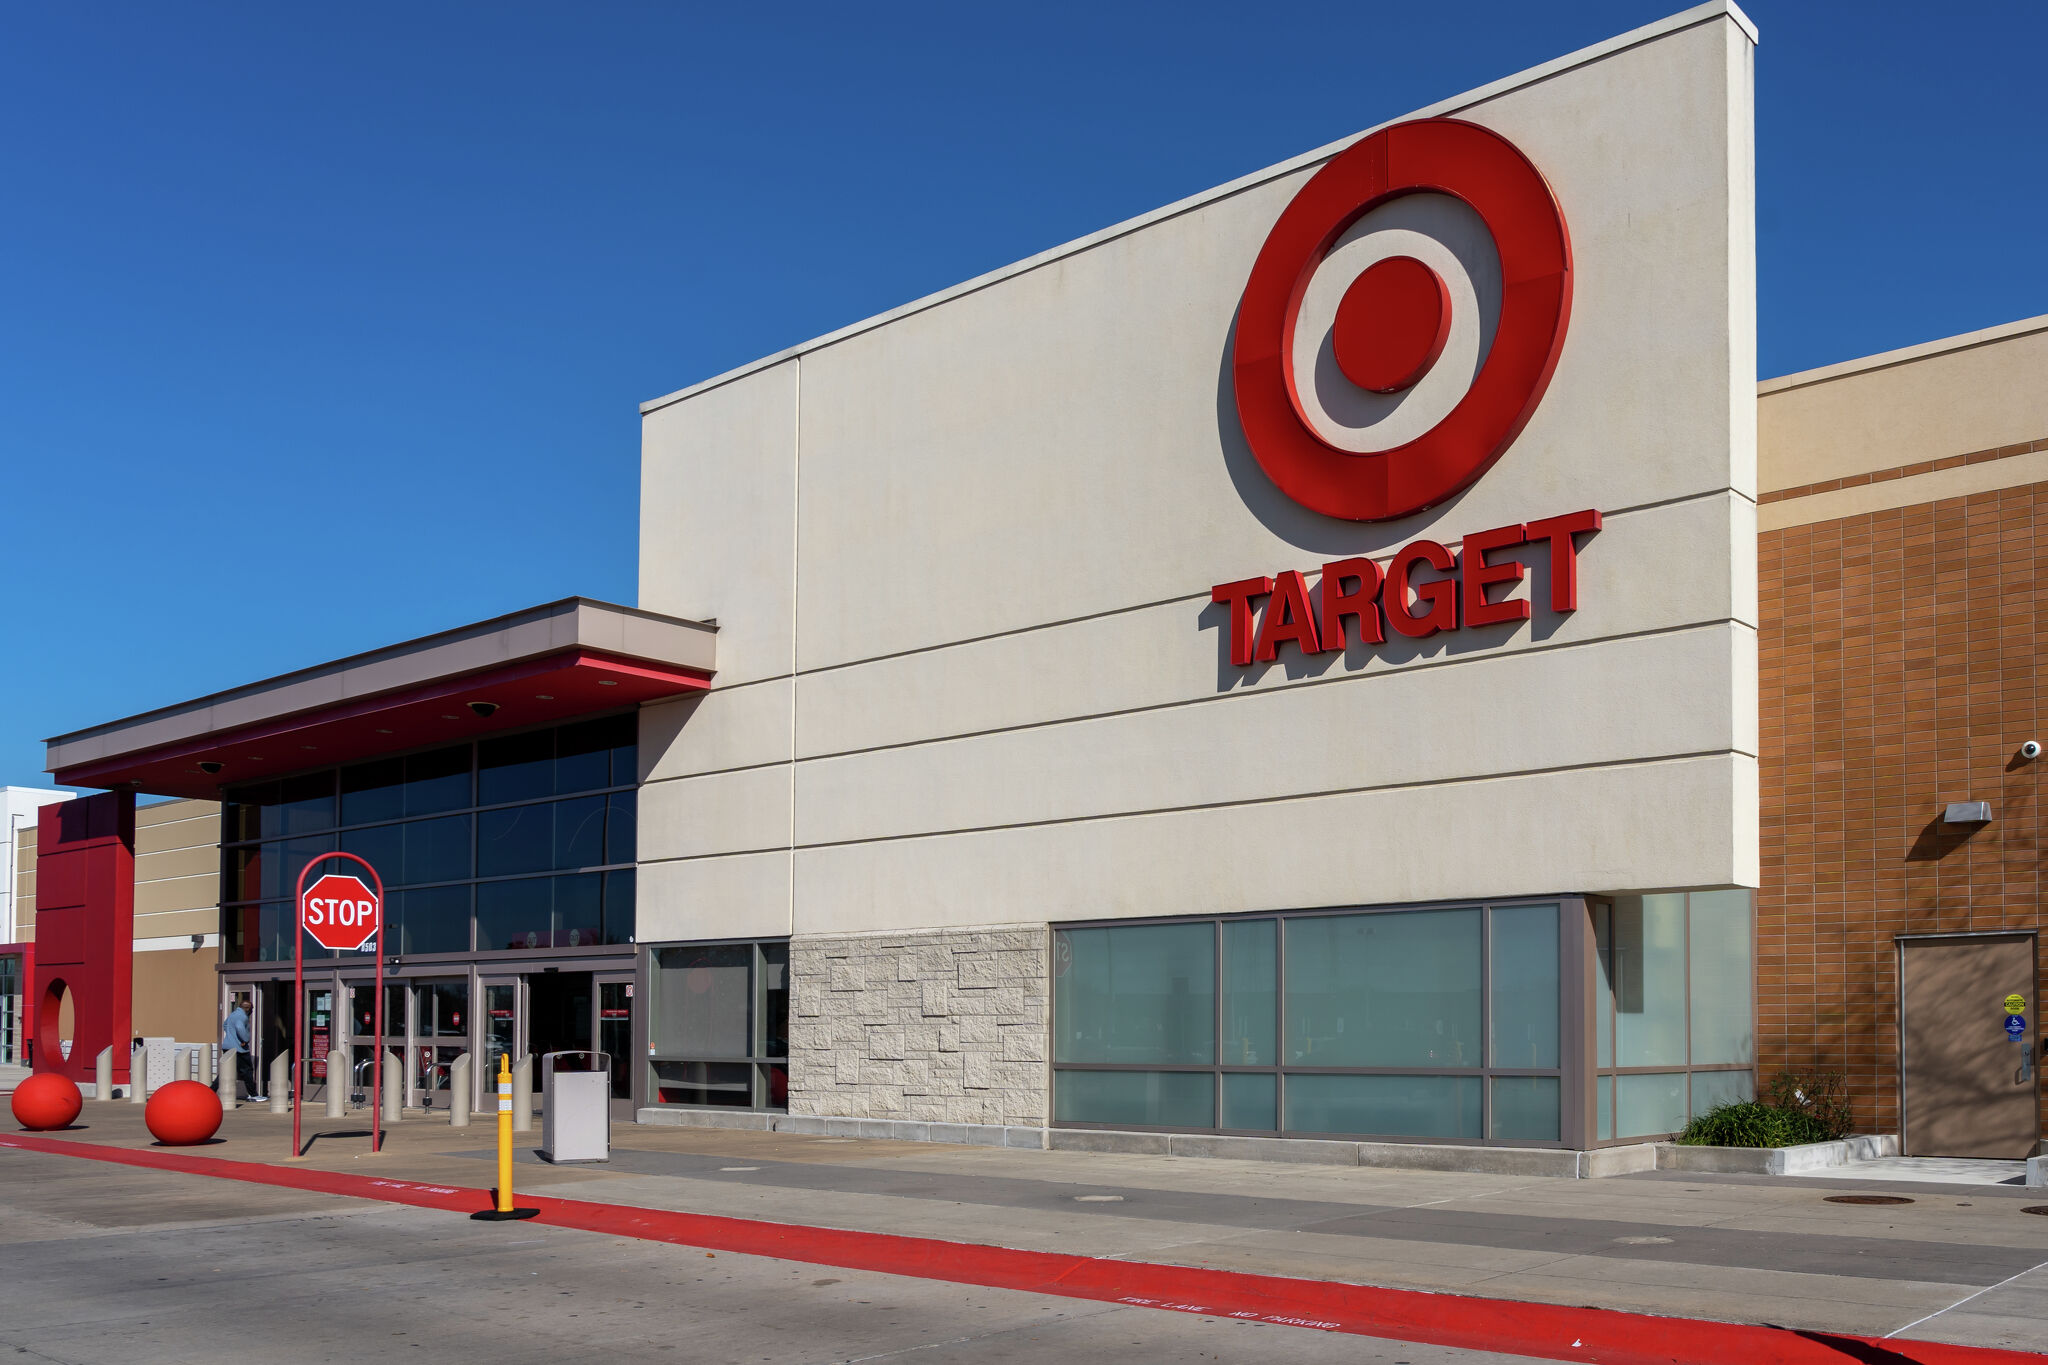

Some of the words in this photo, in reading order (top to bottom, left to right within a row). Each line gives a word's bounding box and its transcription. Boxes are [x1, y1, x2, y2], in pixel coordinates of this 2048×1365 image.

[1212, 509, 1602, 666] TARGET
[308, 897, 373, 926] STOP
[1262, 1314, 1341, 1329] PARKING
